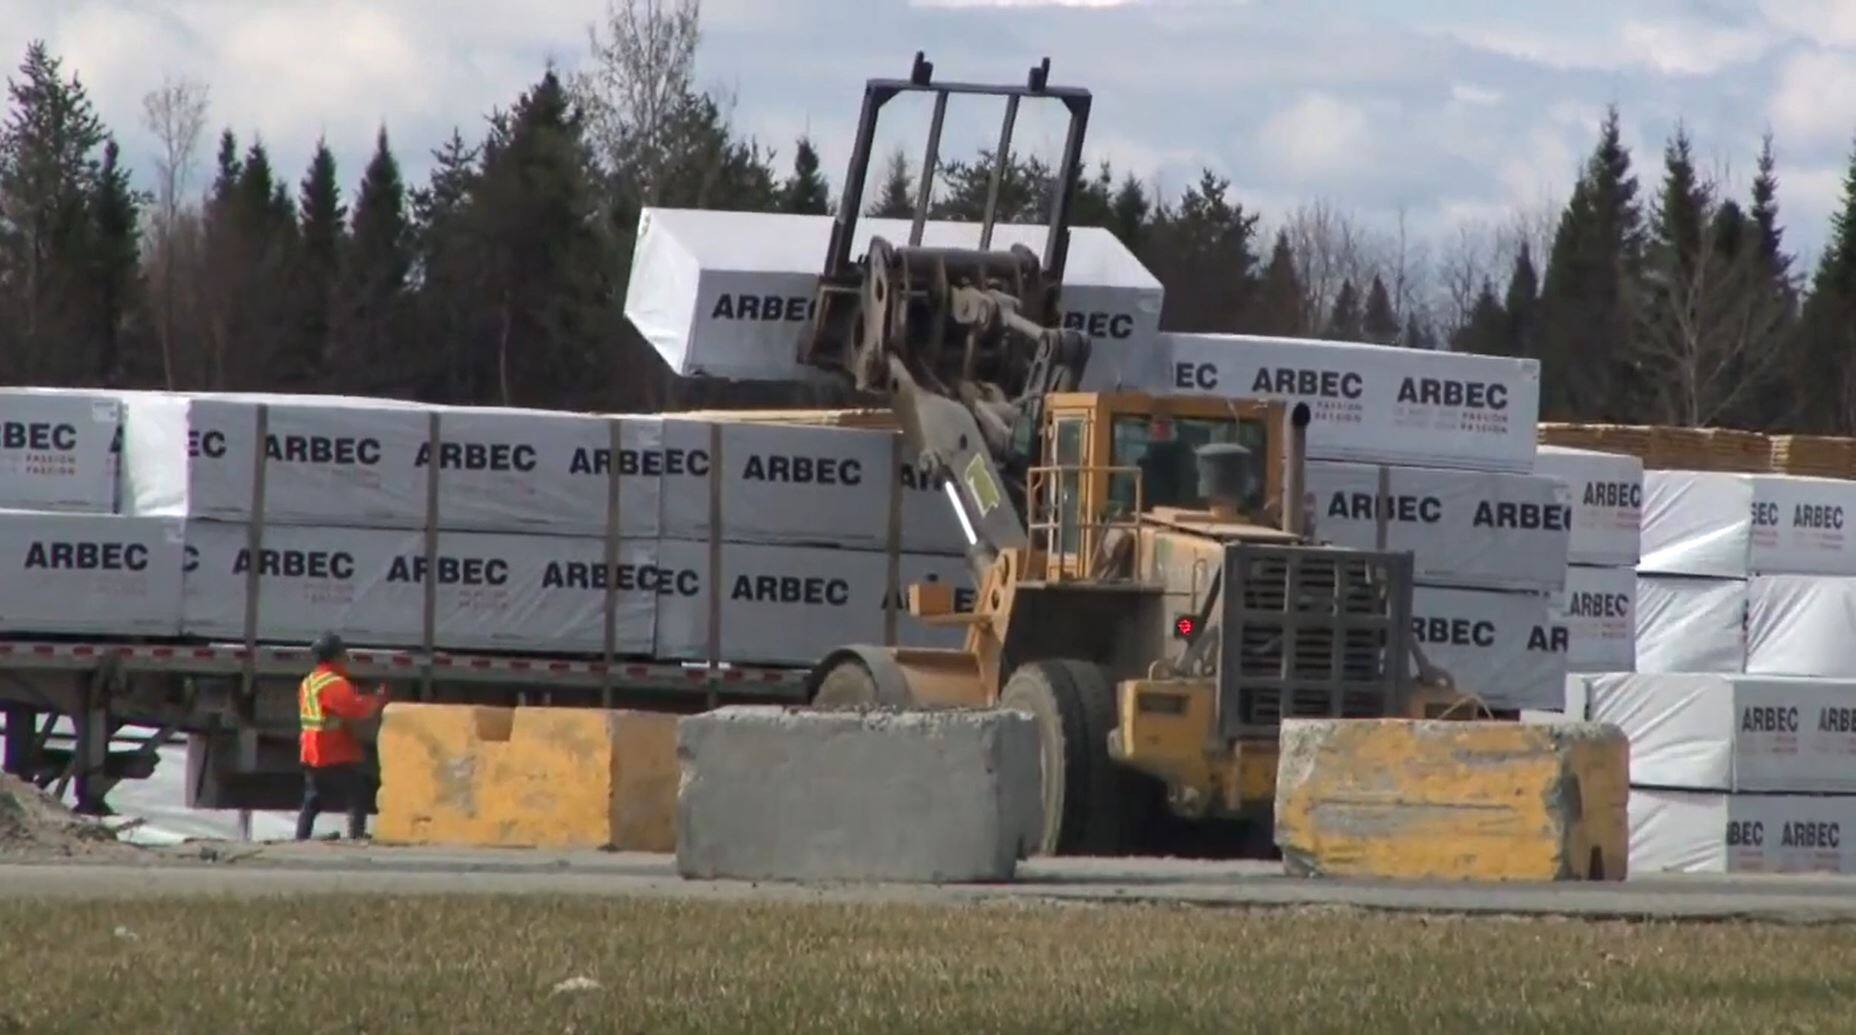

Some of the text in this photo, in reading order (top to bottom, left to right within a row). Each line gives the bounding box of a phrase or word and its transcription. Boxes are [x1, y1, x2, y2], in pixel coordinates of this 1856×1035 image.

[1251, 367, 1363, 398] ARBEC
[1397, 377, 1508, 410] ARBEC
[265, 434, 381, 465] ARBEC
[414, 442, 537, 472] ARBEC
[742, 455, 862, 486] ARBEC
[1583, 482, 1641, 508] ARBEC
[1793, 504, 1844, 530] ARBEC
[24, 542, 148, 571] ARBEC
[231, 548, 354, 579] ARBEC
[541, 561, 658, 592] ARBEC
[731, 575, 849, 606] ARBEC
[1570, 592, 1629, 618] ARBEC
[1742, 706, 1799, 732] ARBEC
[1781, 821, 1840, 848] ARBEC
